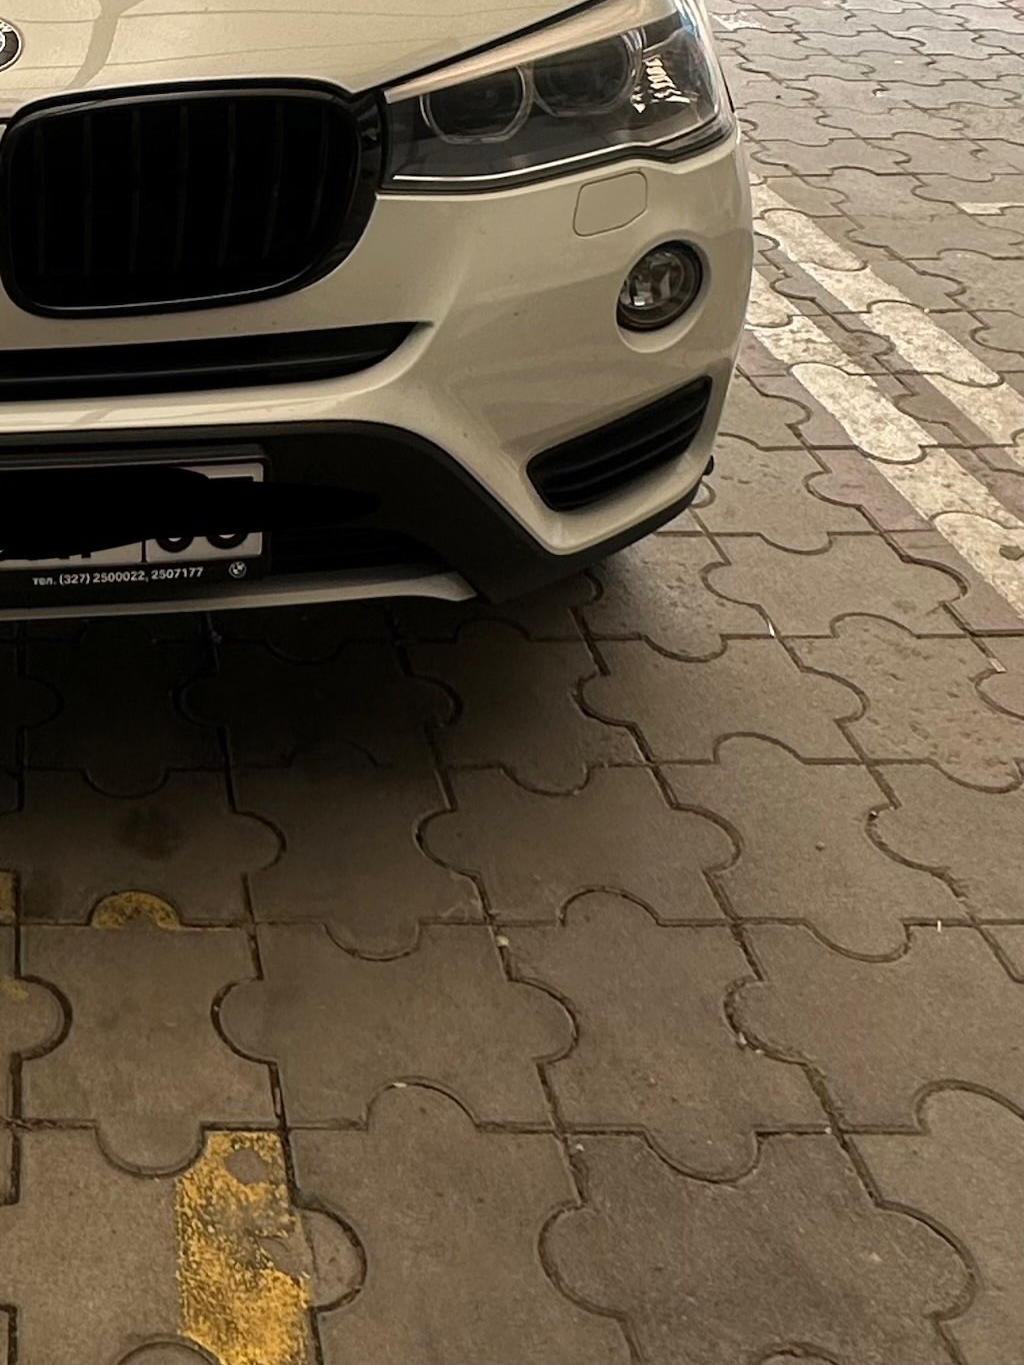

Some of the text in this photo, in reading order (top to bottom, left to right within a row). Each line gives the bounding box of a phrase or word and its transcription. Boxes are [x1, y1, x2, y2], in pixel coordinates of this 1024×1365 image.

[32, 566, 204, 586] тел. (327) 2500022, 2507177
